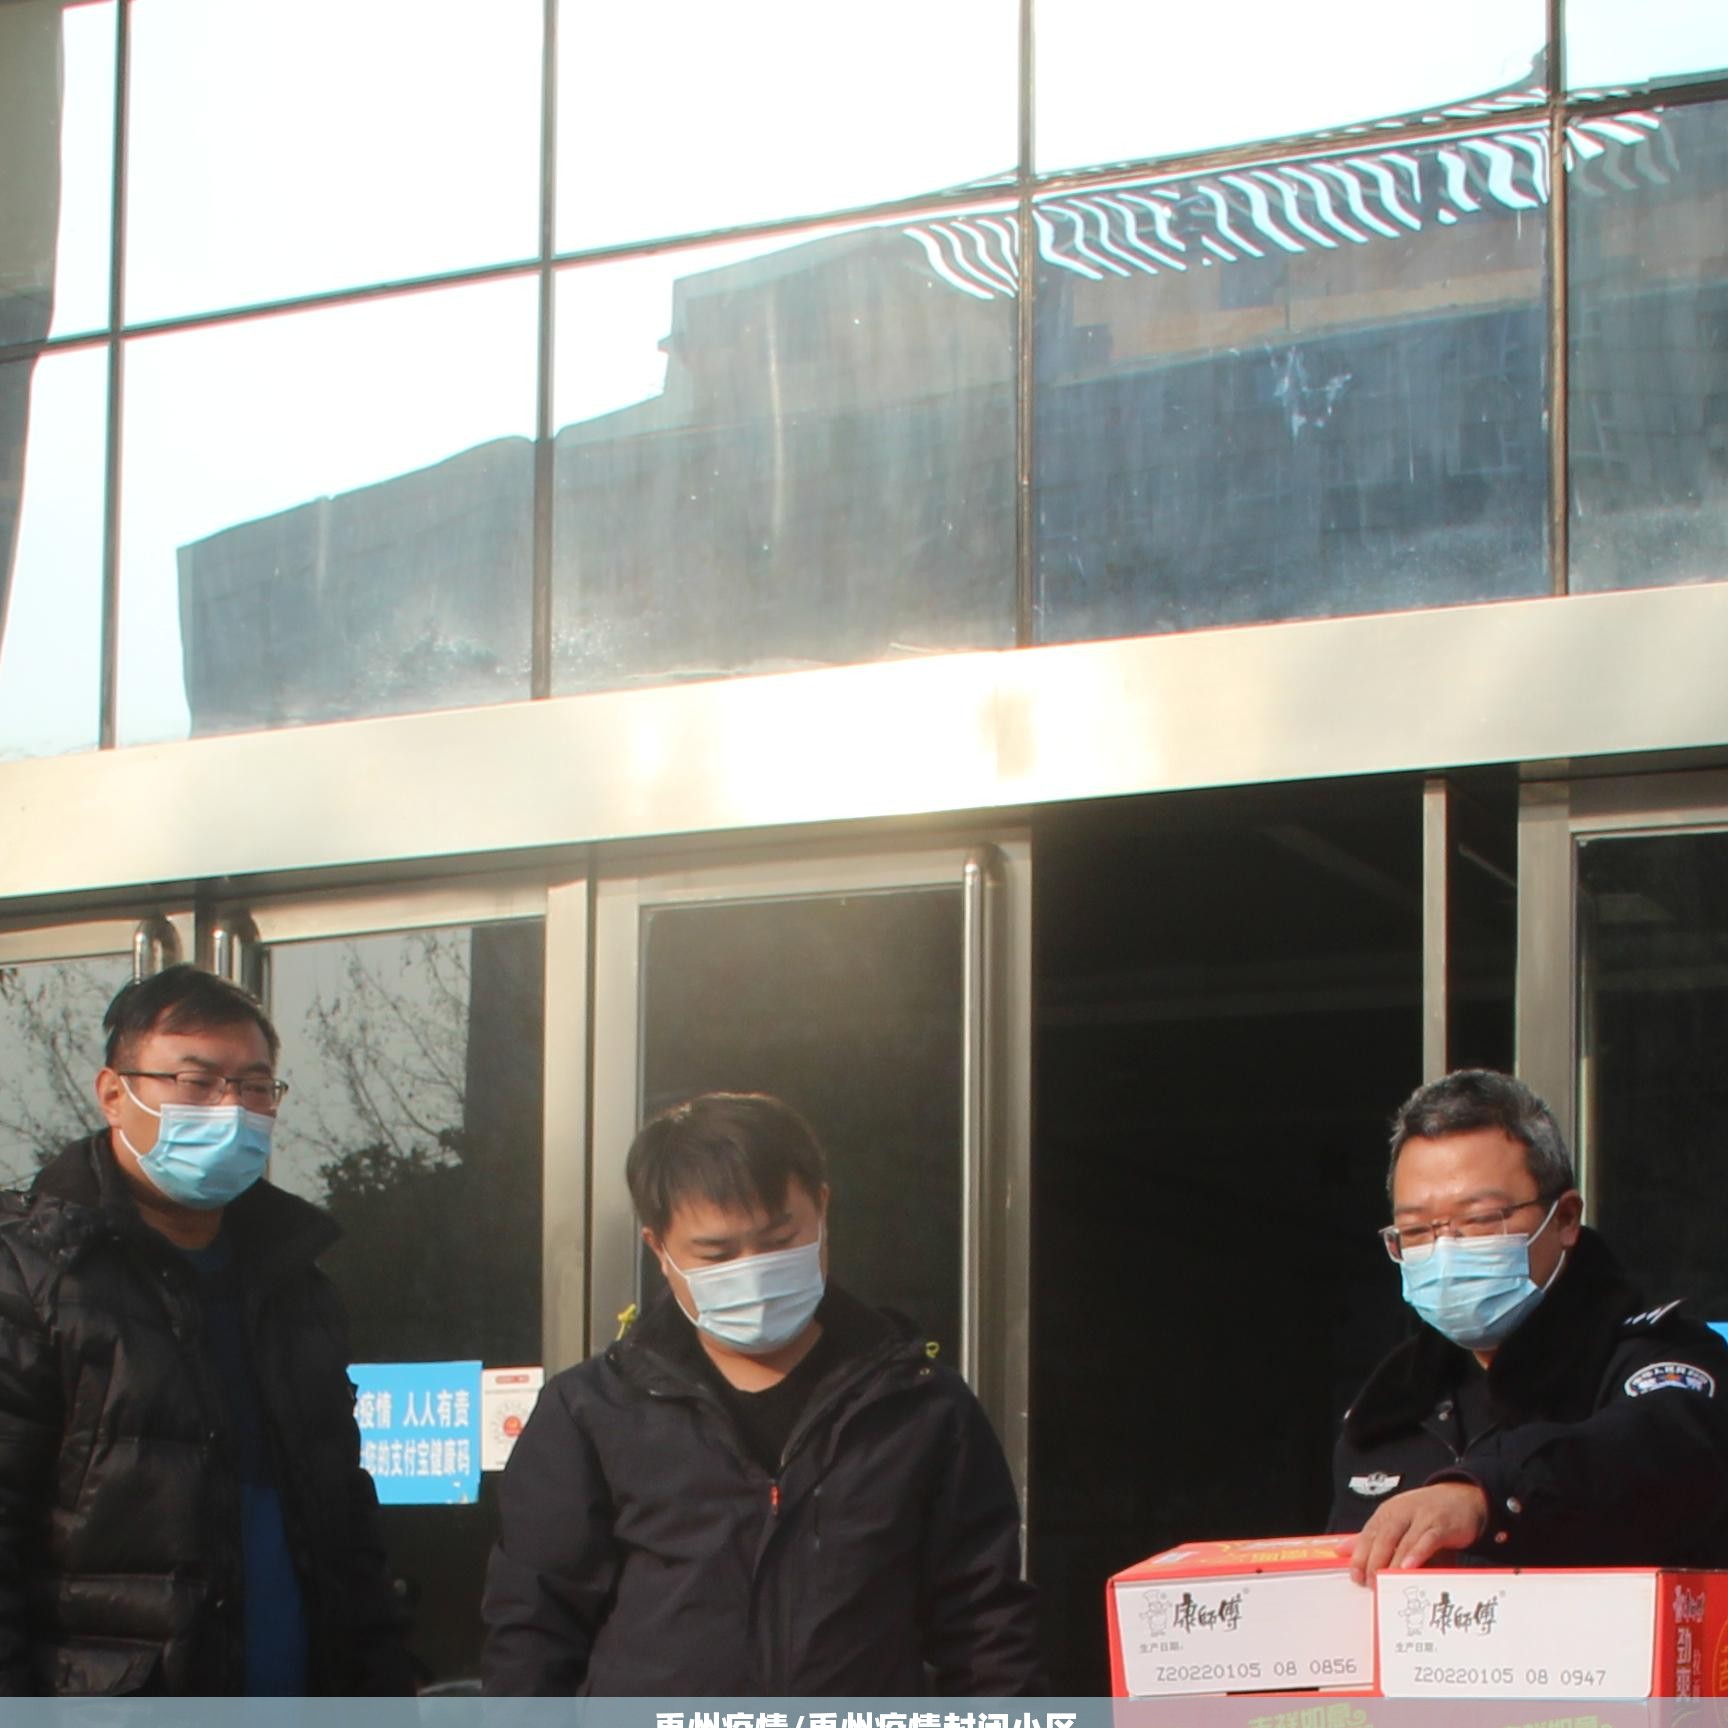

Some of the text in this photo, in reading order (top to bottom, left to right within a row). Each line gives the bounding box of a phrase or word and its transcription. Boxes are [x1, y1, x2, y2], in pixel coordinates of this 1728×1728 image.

[403, 1389, 470, 1428] 人人有责
[1156, 1658, 1357, 1682] Z20220105 08 0856
[1414, 1666, 1606, 1686] Z20220105 08 0947
